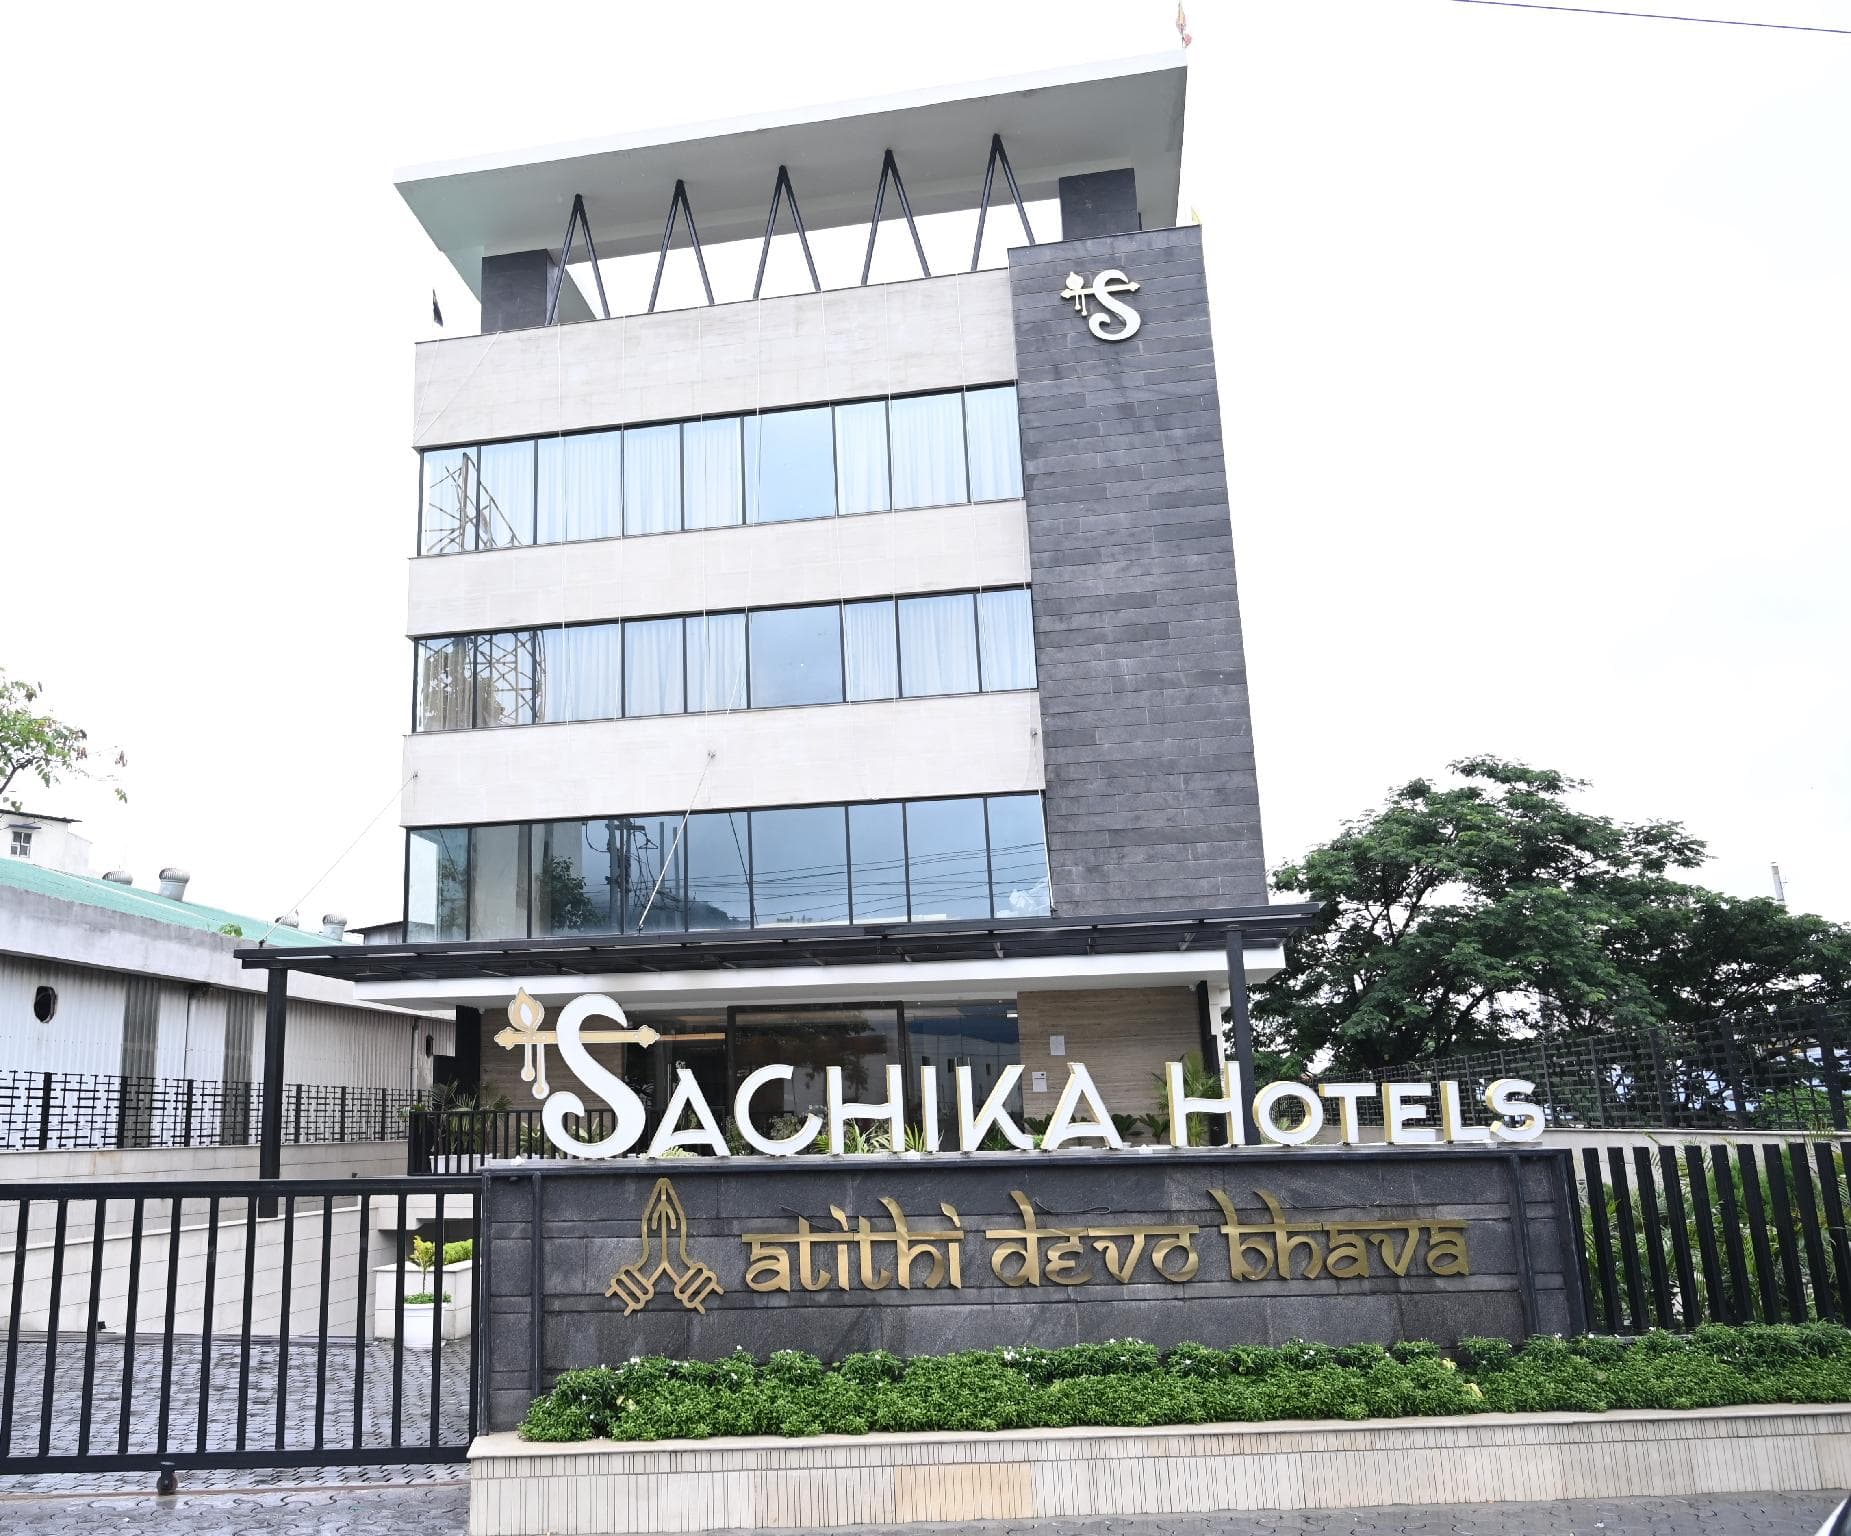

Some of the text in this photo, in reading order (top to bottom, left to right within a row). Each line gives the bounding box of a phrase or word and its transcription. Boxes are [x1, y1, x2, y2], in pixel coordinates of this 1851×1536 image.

[541, 993, 1546, 1158] SACHIKA HOTELS
[741, 1187, 1470, 1292] atithi devo bhava
